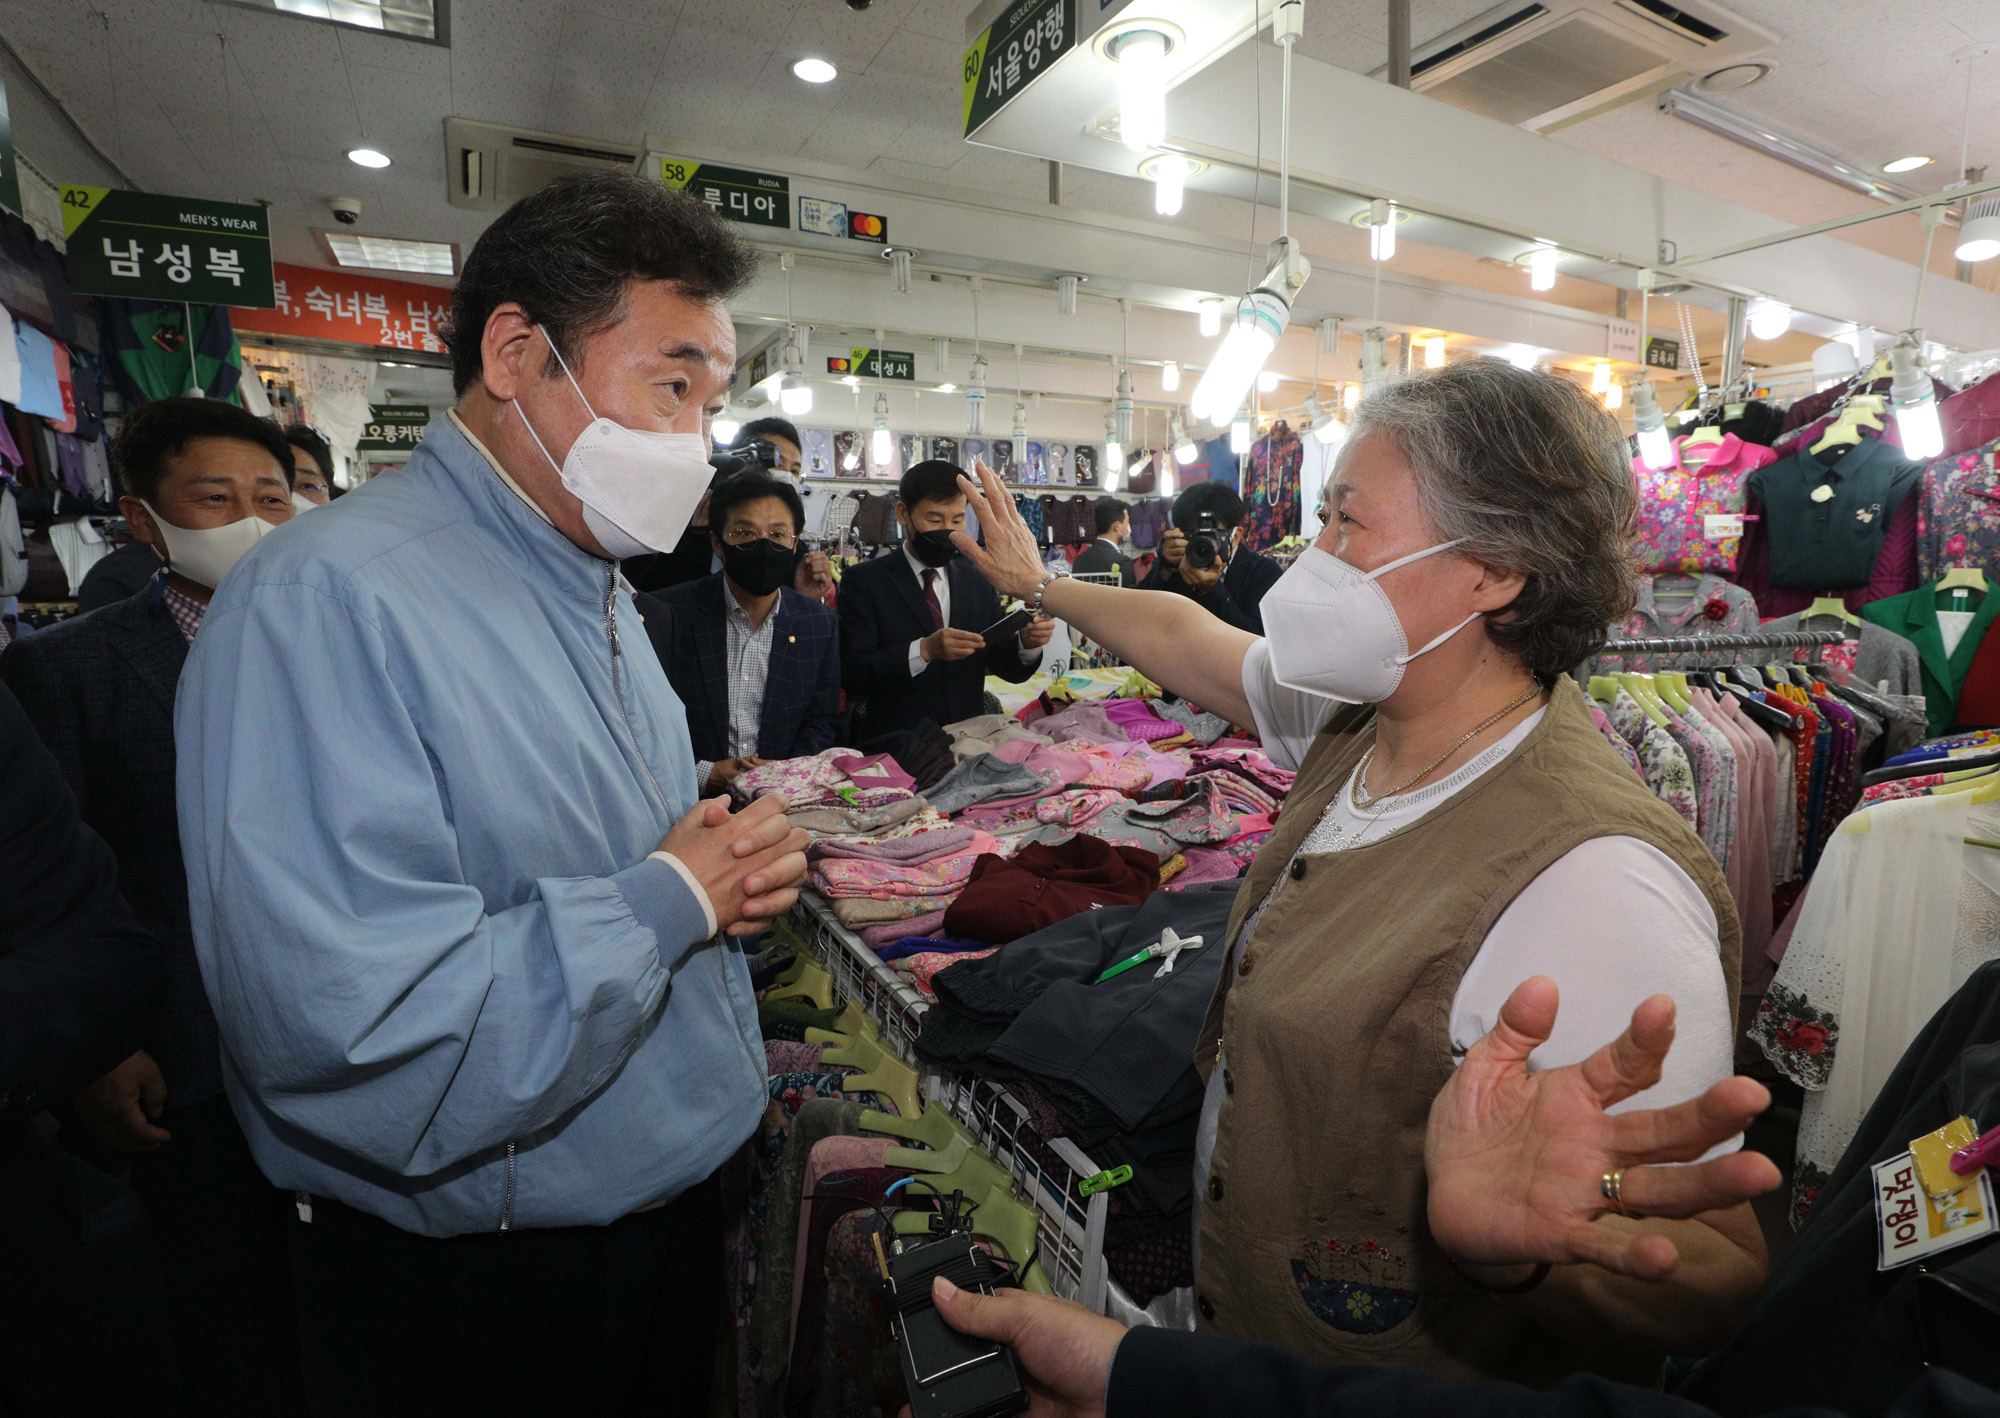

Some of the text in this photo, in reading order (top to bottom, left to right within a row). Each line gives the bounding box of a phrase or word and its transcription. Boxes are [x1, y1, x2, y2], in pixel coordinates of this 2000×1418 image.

[1010, 0, 1038, 27] SEOULY
[986, 0, 1065, 98] 서울양행
[965, 50, 979, 83] 60
[665, 163, 686, 181] 58
[758, 178, 780, 188] RUDIA
[63, 190, 91, 209] 42
[703, 187, 776, 220] 루디아
[179, 212, 258, 231] MEN'S WEAR
[102, 237, 245, 287] 남성복
[380, 328, 450, 354] 2번 출
[852, 350, 863, 359] 46
[1882, 1166, 1919, 1249] 멋쟁이
